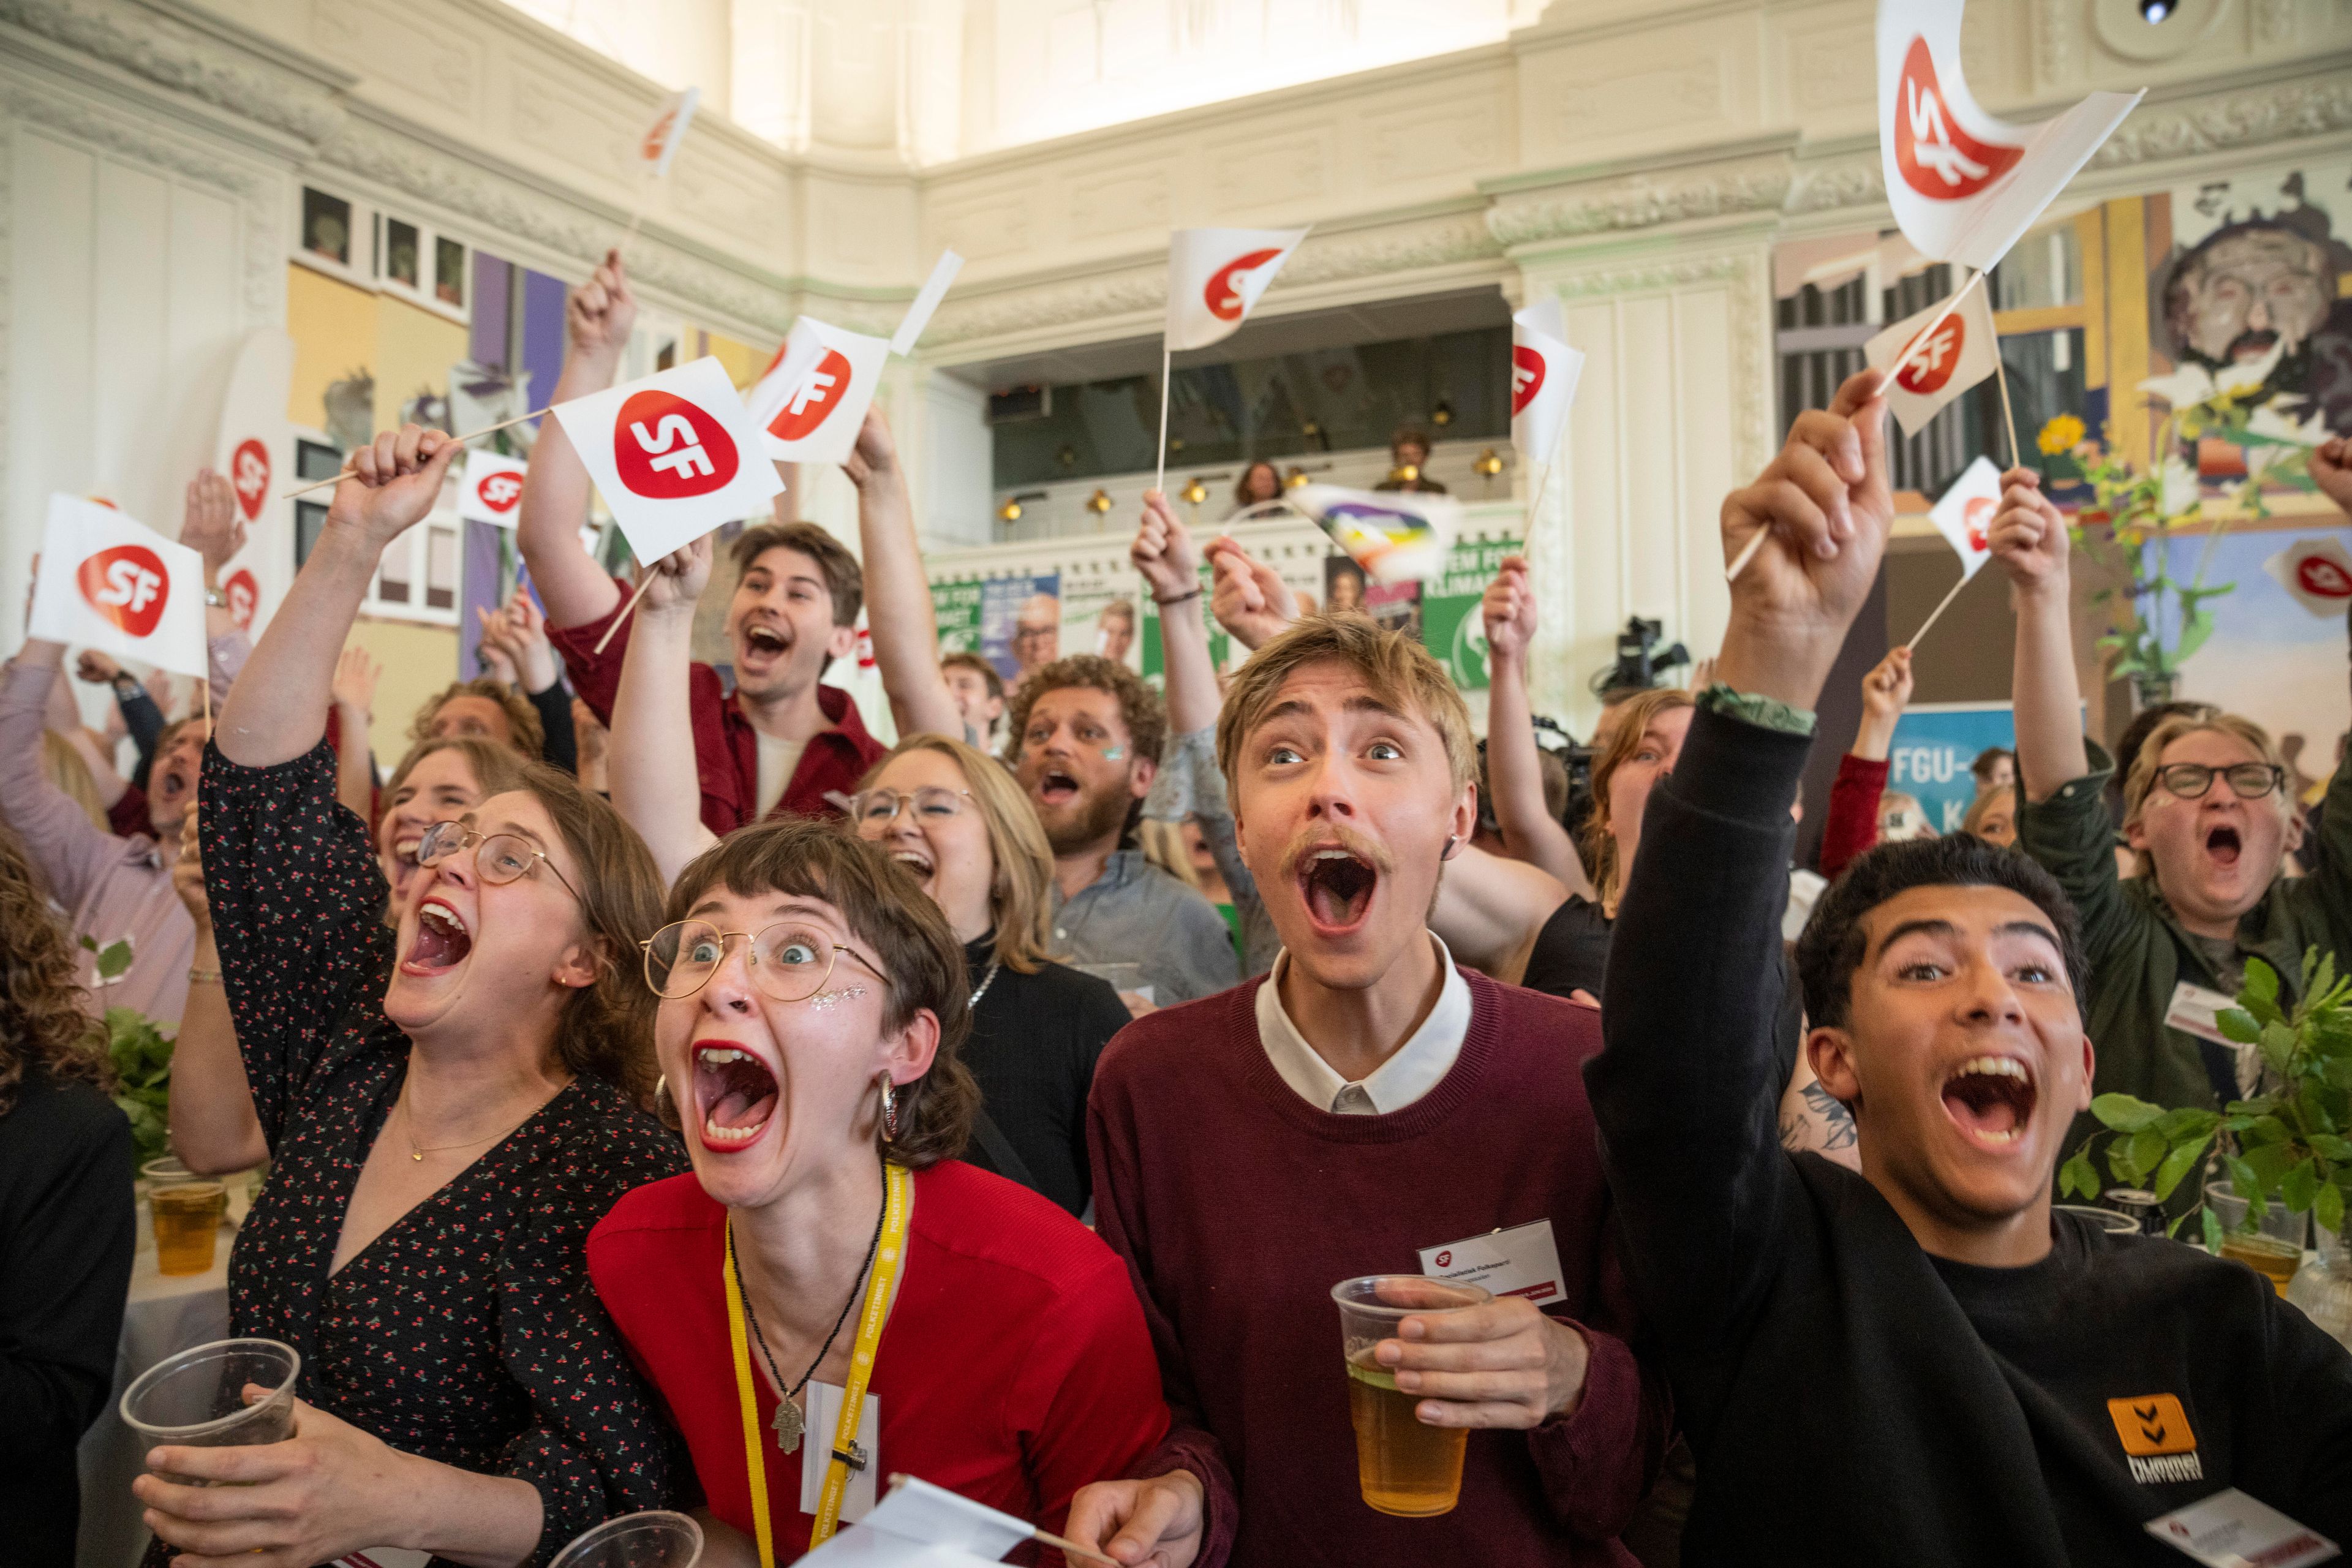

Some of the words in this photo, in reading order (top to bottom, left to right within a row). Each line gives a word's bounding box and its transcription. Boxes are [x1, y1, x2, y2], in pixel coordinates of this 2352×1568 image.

[789, 371, 837, 416] F
[630, 413, 715, 480] SF
[483, 477, 521, 504] SF
[97, 559, 161, 614] SF
[1892, 746, 1971, 784] FGU-
[1438, 1254, 1450, 1265] SF
[864, 1276, 888, 1340] FOLKETINGET
[842, 1380, 861, 1440] FOLKETINGET
[820, 1480, 839, 1539] FOLKETINGET
